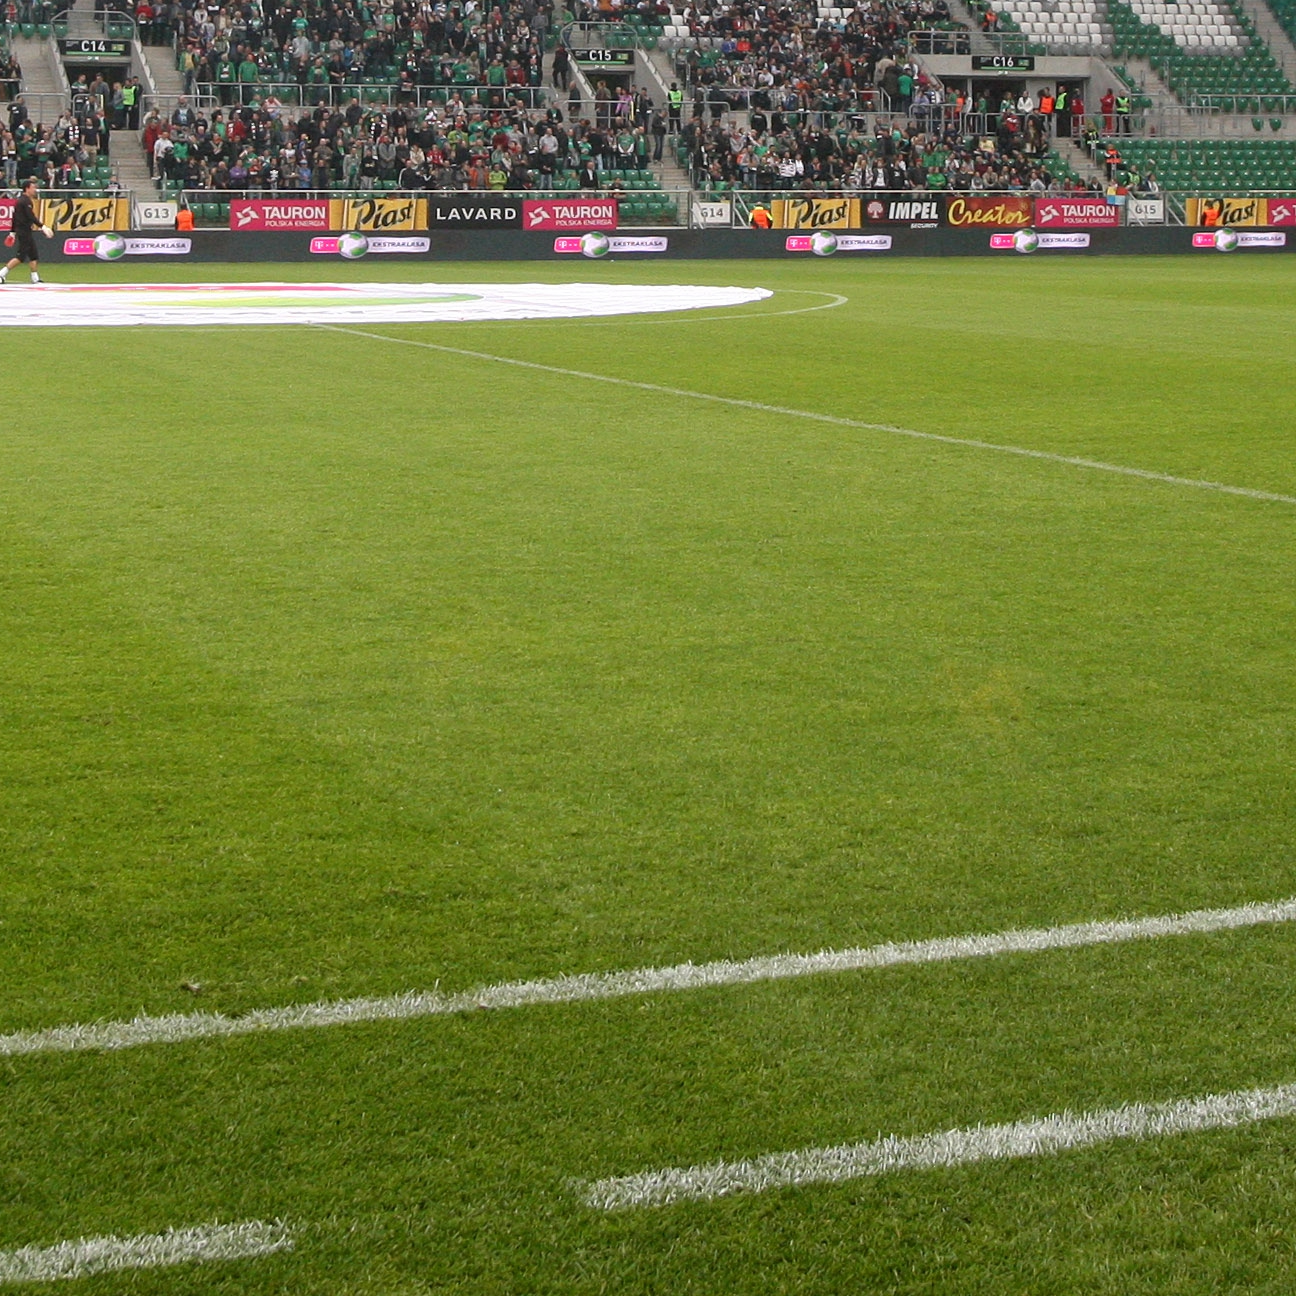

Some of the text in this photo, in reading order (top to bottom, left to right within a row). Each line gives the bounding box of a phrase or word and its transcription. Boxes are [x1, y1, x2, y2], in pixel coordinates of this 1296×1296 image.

[81, 40, 106, 52] C14
[589, 50, 612, 61] C15
[993, 56, 1014, 67] C16
[50, 198, 114, 230] Piast
[144, 208, 169, 219] G13
[263, 206, 325, 219] TAURON
[351, 198, 414, 230] Piast
[436, 207, 517, 220] LAVARD
[553, 205, 613, 219] TAURON
[792, 198, 847, 229] Piast
[888, 202, 939, 220] IMPEL
[948, 199, 1031, 225] Creator
[1061, 205, 1115, 217] TAURON
